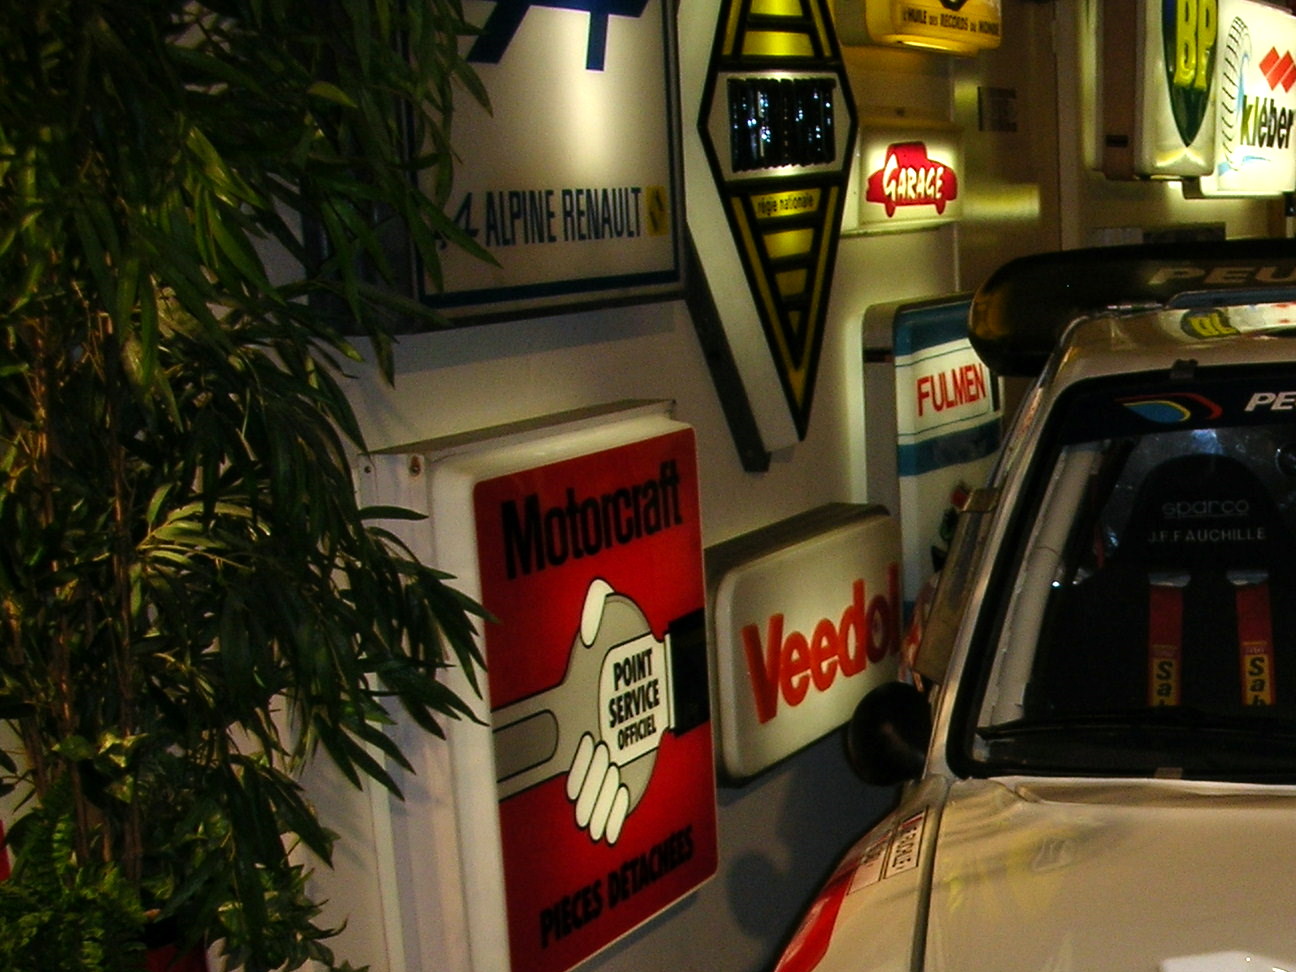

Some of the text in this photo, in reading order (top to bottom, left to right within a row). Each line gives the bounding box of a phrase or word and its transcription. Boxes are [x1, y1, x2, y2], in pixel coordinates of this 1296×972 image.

[882, 152, 944, 201] GARAGE
[485, 189, 557, 247] ALPINE
[561, 186, 642, 242] RENAULT
[916, 362, 987, 417] FULMEN
[503, 459, 682, 580] Motorcraft
[1161, 499, 1249, 519] sparco
[740, 561, 900, 725] Veedol
[612, 647, 653, 692] POINT
[608, 678, 660, 729] SERVICE
[617, 713, 657, 751] OFFICIEL
